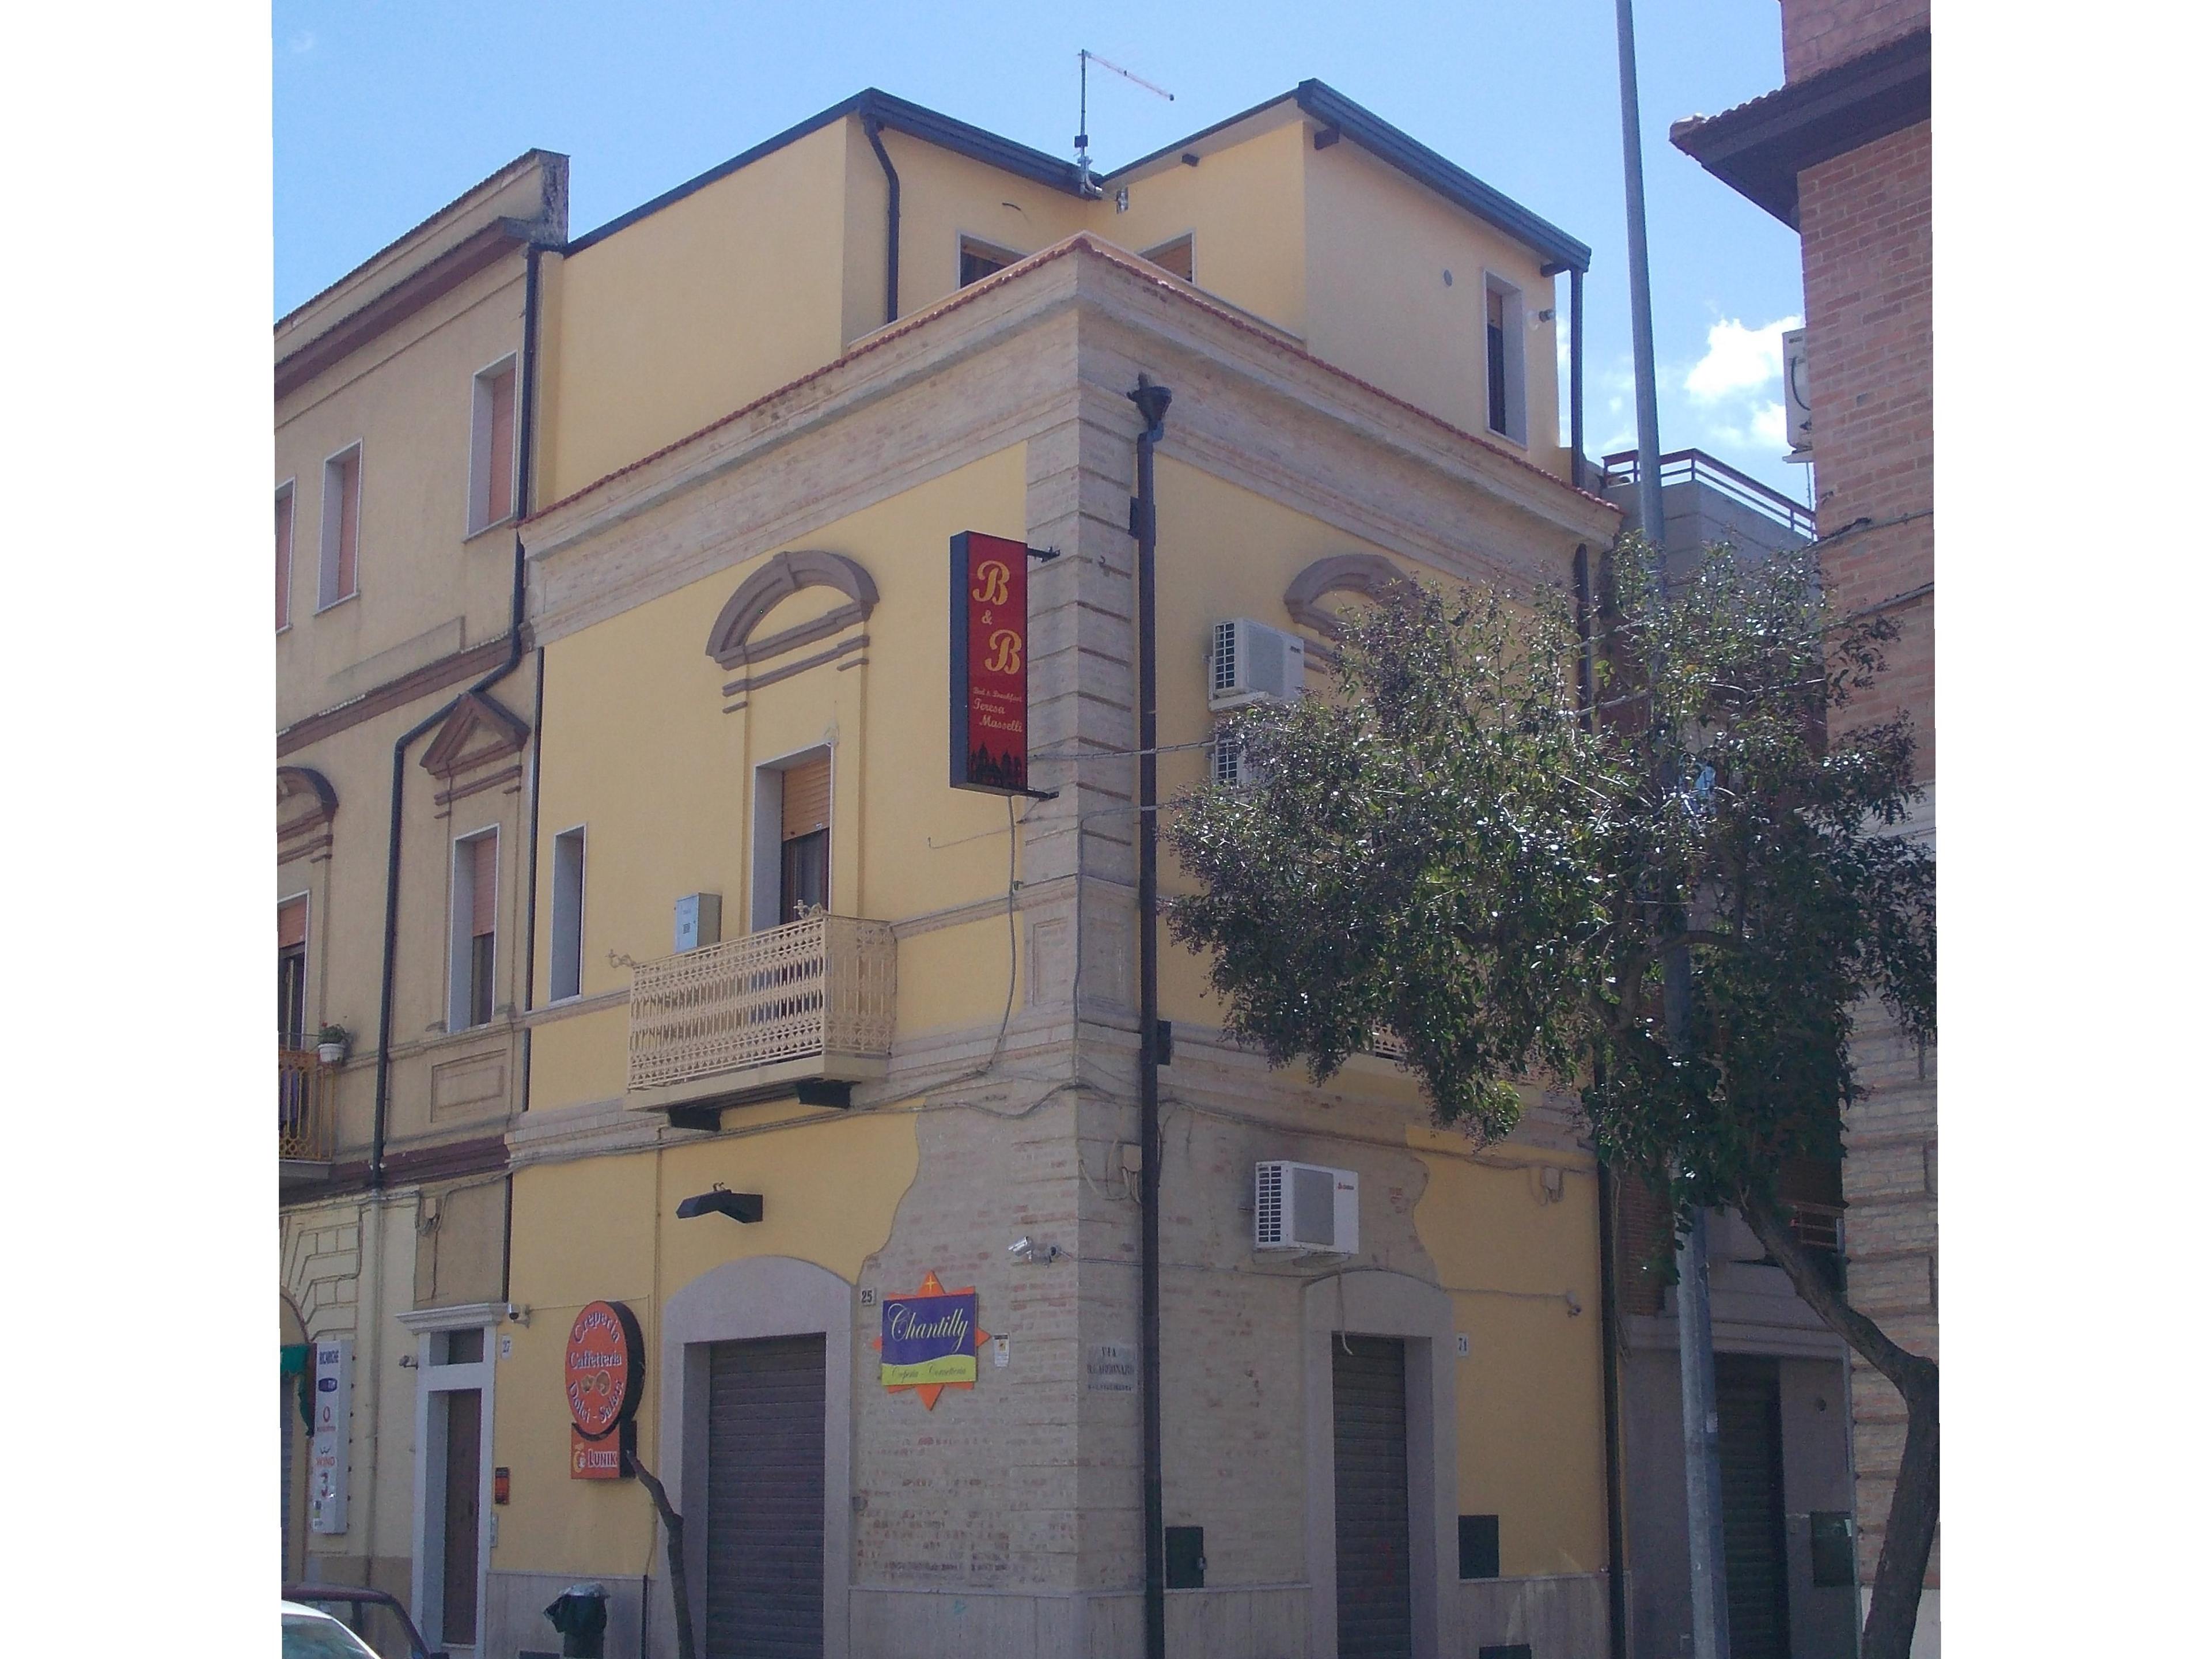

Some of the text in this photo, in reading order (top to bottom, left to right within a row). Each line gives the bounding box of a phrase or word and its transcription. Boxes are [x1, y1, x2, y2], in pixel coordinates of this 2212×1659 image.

[972, 560, 1010, 605] B
[982, 609, 993, 625] &
[984, 629, 1022, 675] B
[973, 698, 1005, 714] Teresa
[861, 1290, 872, 1303] 25
[574, 1312, 620, 1343] Creperia
[888, 1303, 968, 1354] Chantilly
[570, 1350, 622, 1369] Caffetteria
[1101, 1346, 1116, 1357] VIA
[570, 1380, 590, 1423] Dolci
[316, 1456, 335, 1466] WIND
[588, 1448, 618, 1468] LUNIK
